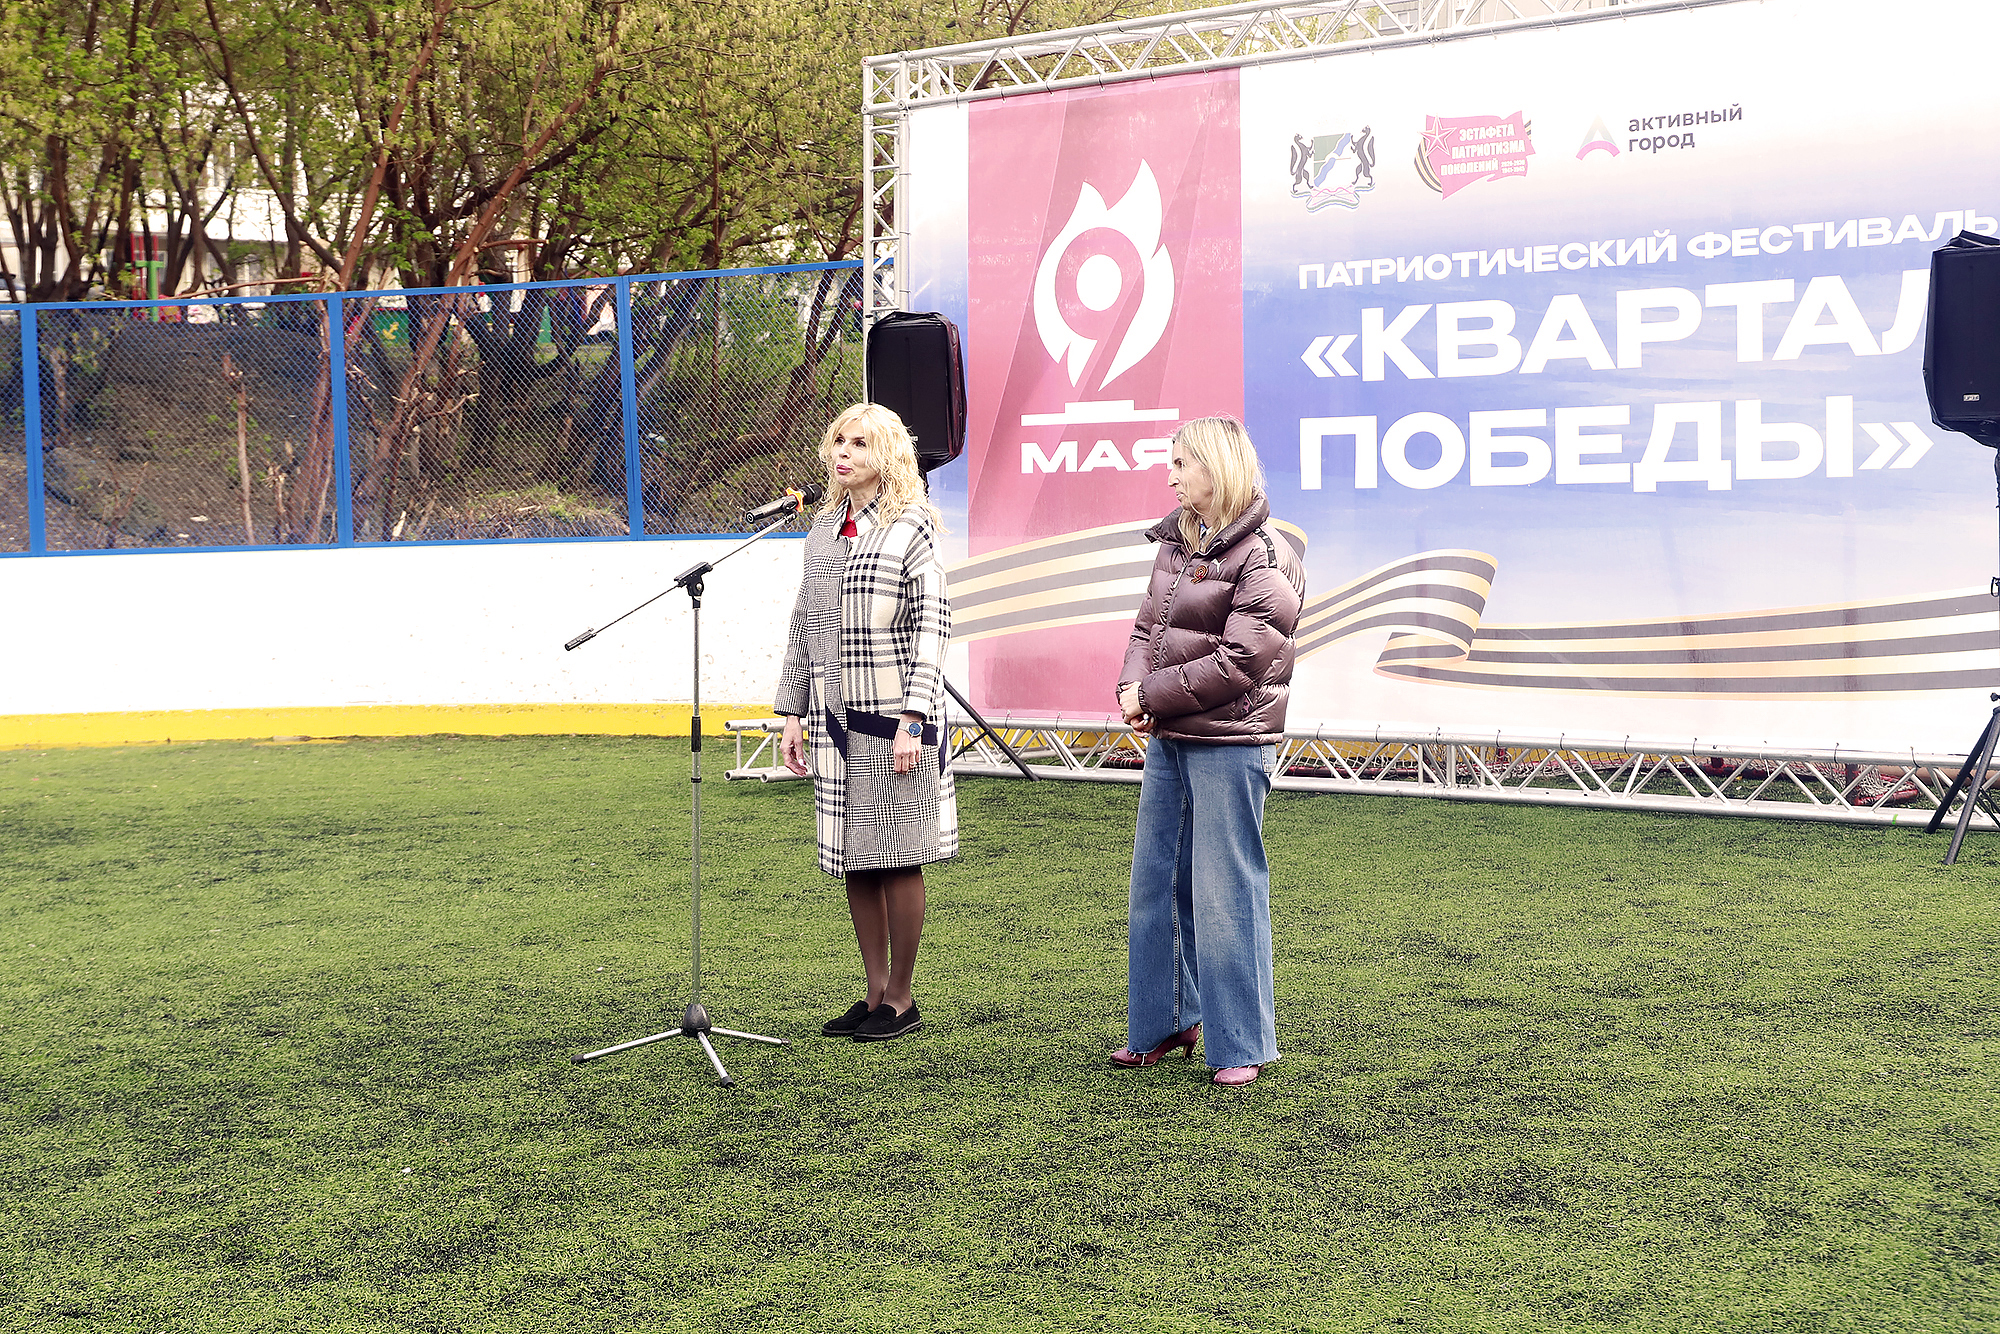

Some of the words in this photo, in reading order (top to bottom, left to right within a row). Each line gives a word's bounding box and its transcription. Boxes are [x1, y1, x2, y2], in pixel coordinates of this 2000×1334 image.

[1628, 103, 1742, 132] активный
[1459, 124, 1516, 142] ЭСТАФЕТА
[1628, 132, 1696, 154] город
[1451, 140, 1526, 159] ПАТРИОТИЗМА
[1440, 158, 1499, 176] ПОКОЛЕНИЙ
[1298, 229, 1678, 290] ПАТРИОТИЧЕСКИЙ
[1685, 209, 1999, 261] ФЕСТИВАЛЬ
[1020, 438, 1173, 474] МАЯ
[1299, 394, 1935, 493] ПОБЕДЫ»
